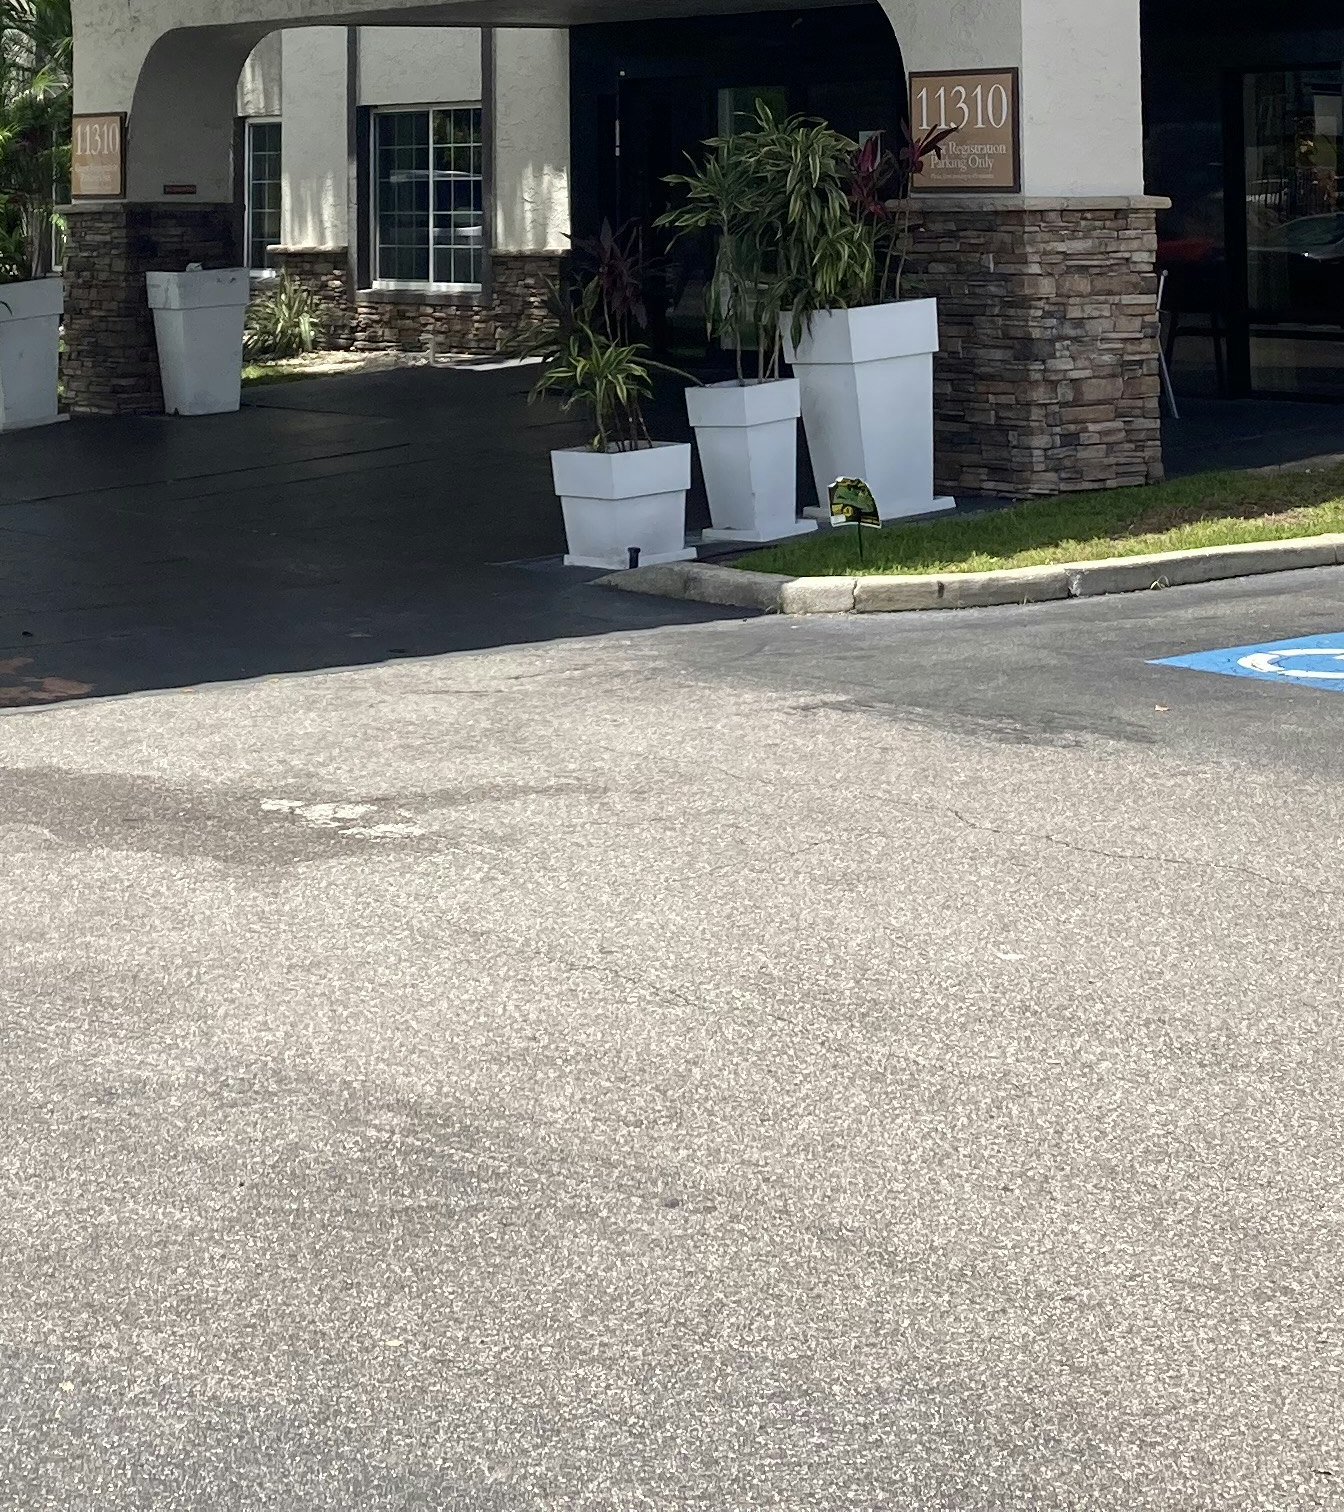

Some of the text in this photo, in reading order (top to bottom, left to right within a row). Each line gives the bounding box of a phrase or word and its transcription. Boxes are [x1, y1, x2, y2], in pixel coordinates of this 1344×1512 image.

[916, 83, 1008, 130] 11310
[75, 124, 119, 155] 11310
[949, 141, 1007, 157] Registration
[930, 154, 995, 172] Parking Only
